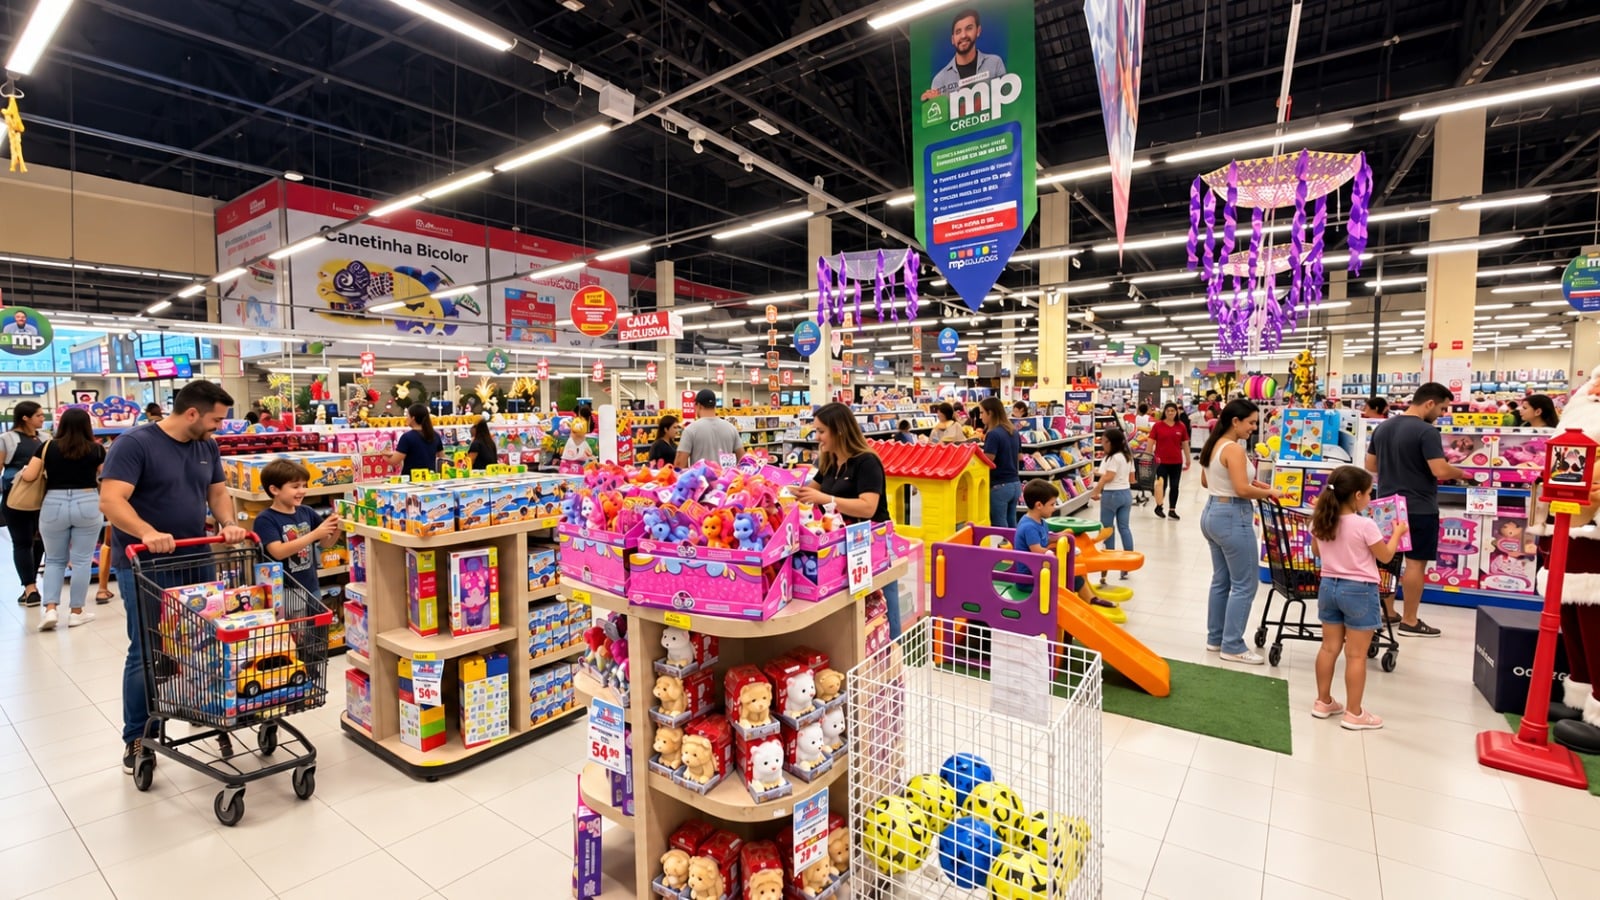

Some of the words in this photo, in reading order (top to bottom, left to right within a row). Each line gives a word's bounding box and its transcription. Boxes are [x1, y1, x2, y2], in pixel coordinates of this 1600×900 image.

[949, 73, 1022, 120] mp
[320, 225, 412, 255] Canetinha
[416, 243, 468, 264] Bicolor
[626, 314, 659, 328] CAIXA
[11, 334, 45, 350] mp
